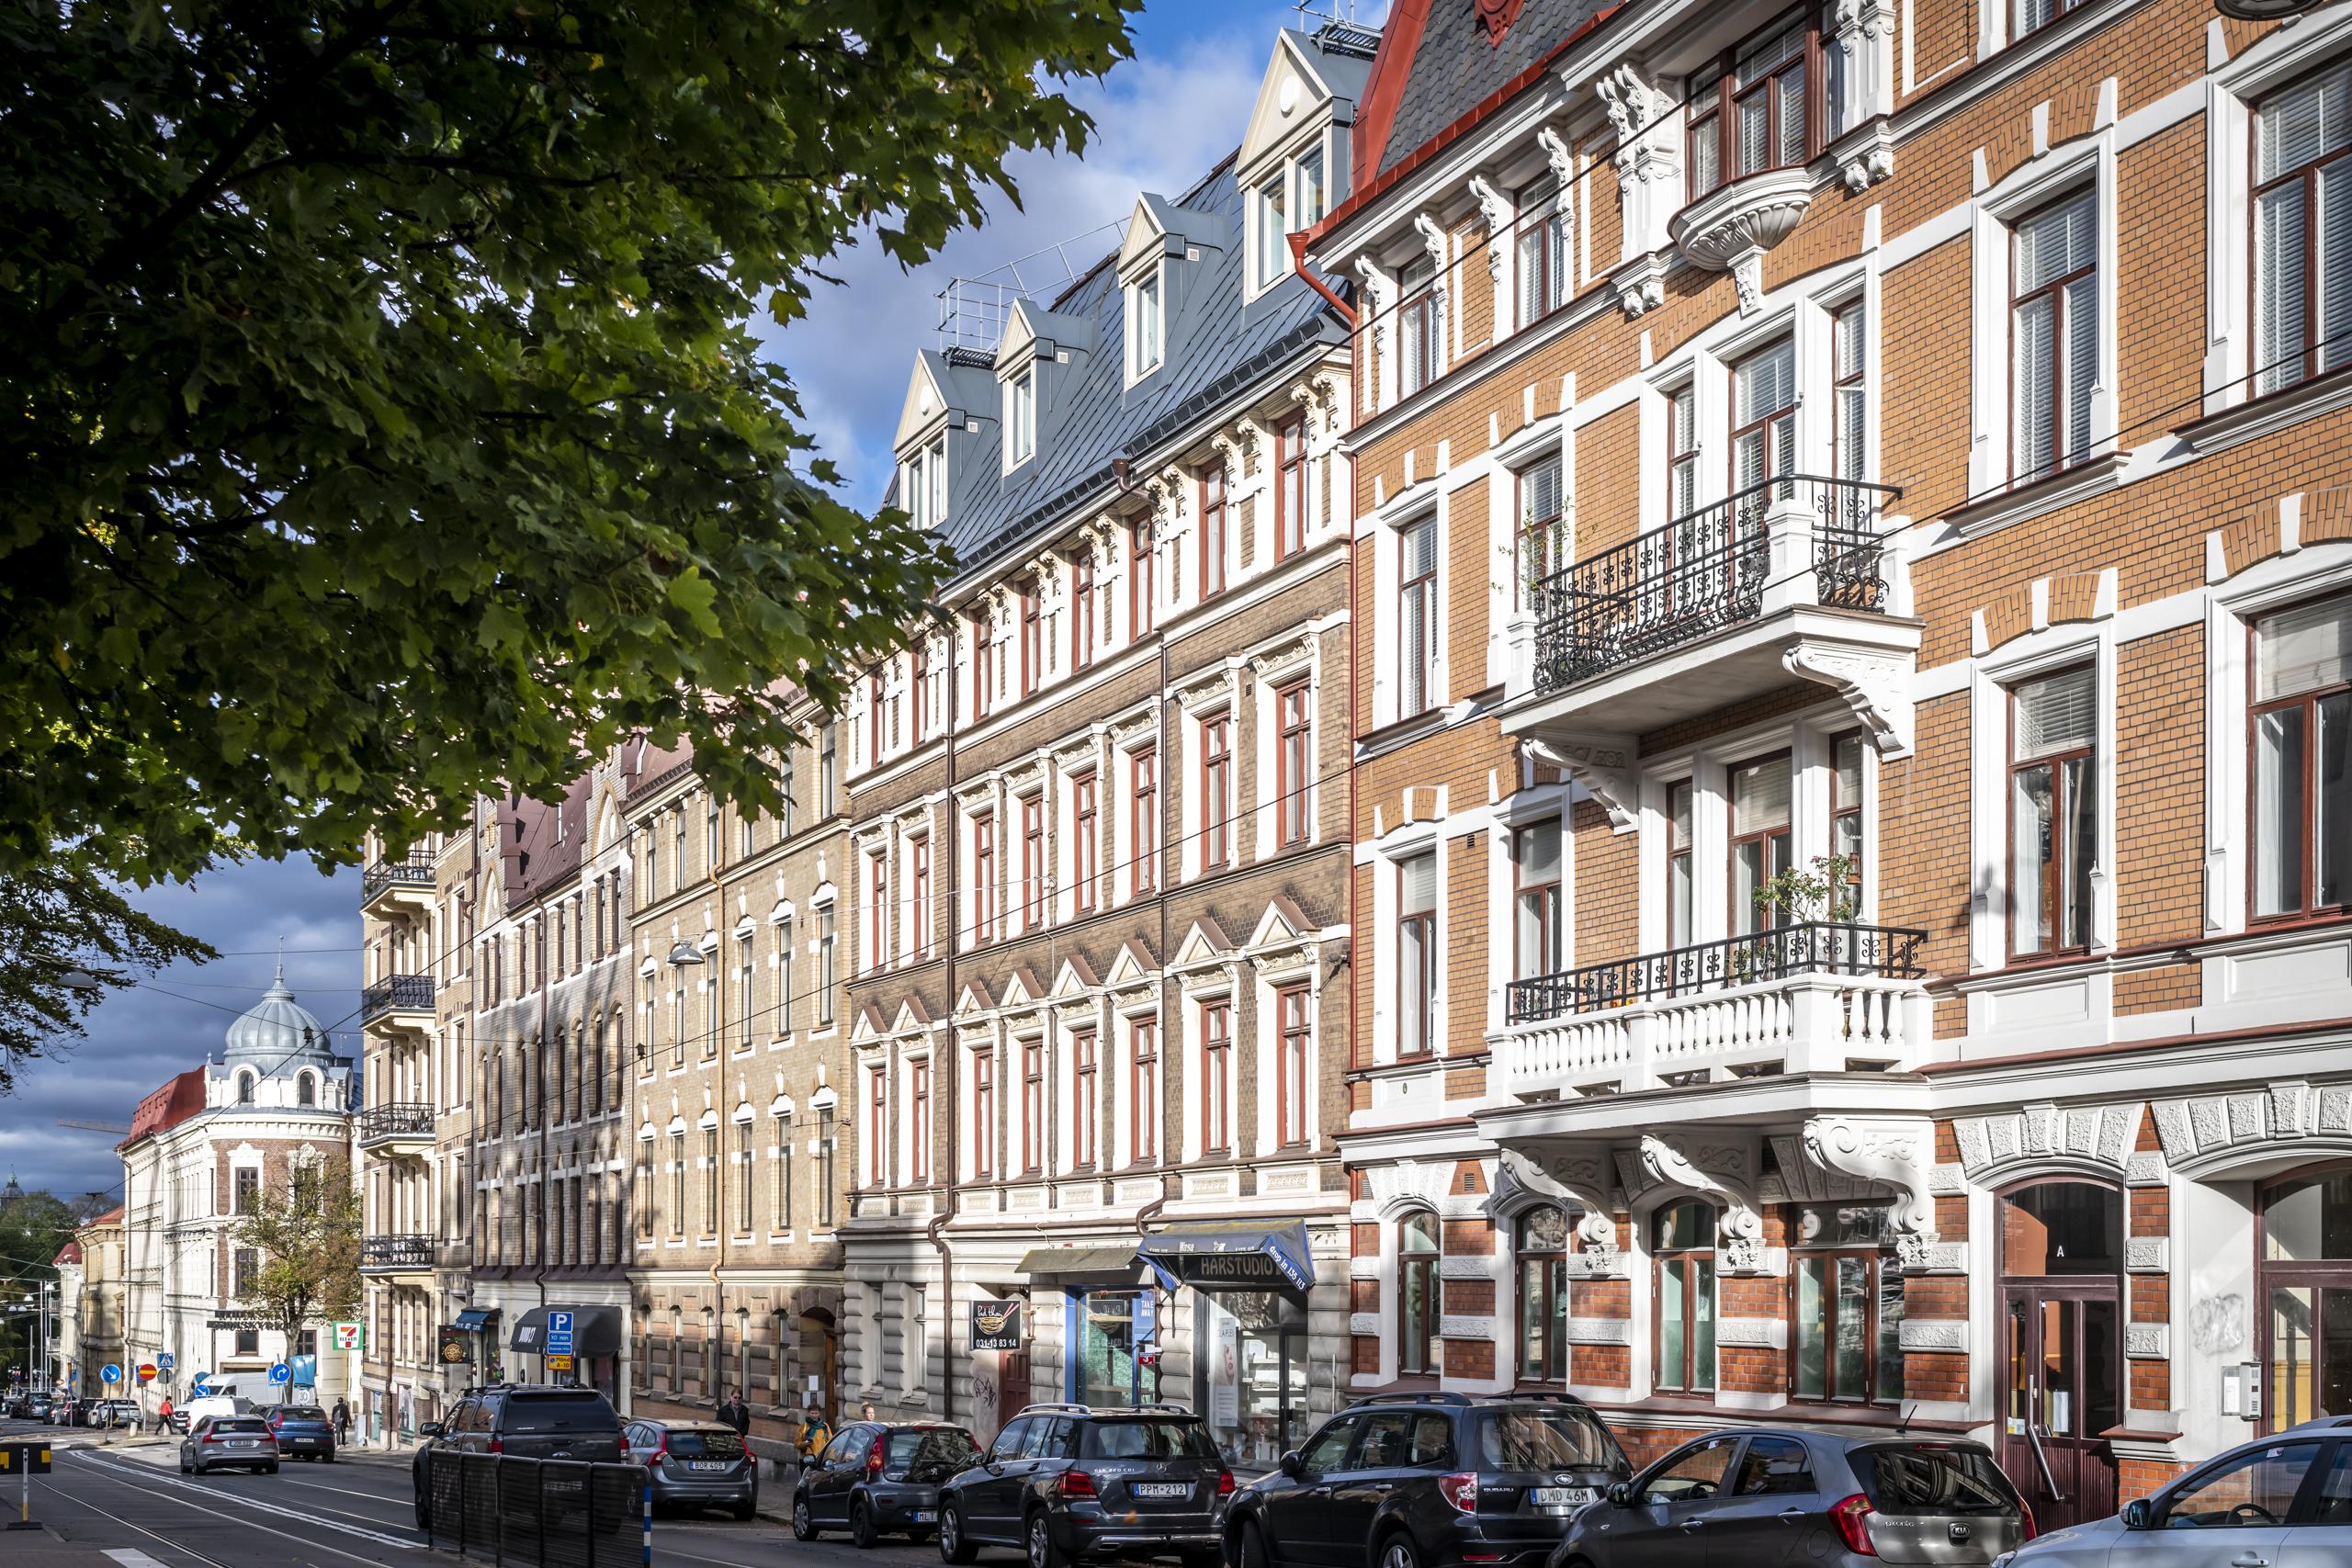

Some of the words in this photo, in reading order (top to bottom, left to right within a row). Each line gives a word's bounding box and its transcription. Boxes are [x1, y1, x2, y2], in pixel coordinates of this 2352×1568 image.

[1179, 1241, 1194, 1252] Wasa
[2056, 1245, 2064, 1258] A
[1269, 1246, 1282, 1262] drop
[1280, 1258, 1288, 1270] in
[1287, 1267, 1298, 1280] 135
[1295, 1278, 1306, 1290] 113
[1141, 1300, 1154, 1309] TAKE
[1140, 1309, 1154, 1317] AWAY
[555, 1314, 568, 1330] P
[976, 1338, 998, 1348] 031-13
[999, 1338, 1007, 1348] 83
[1008, 1338, 1016, 1348] 14
[1540, 1490, 1563, 1502] DMD
[1566, 1490, 1589, 1502] 46M
